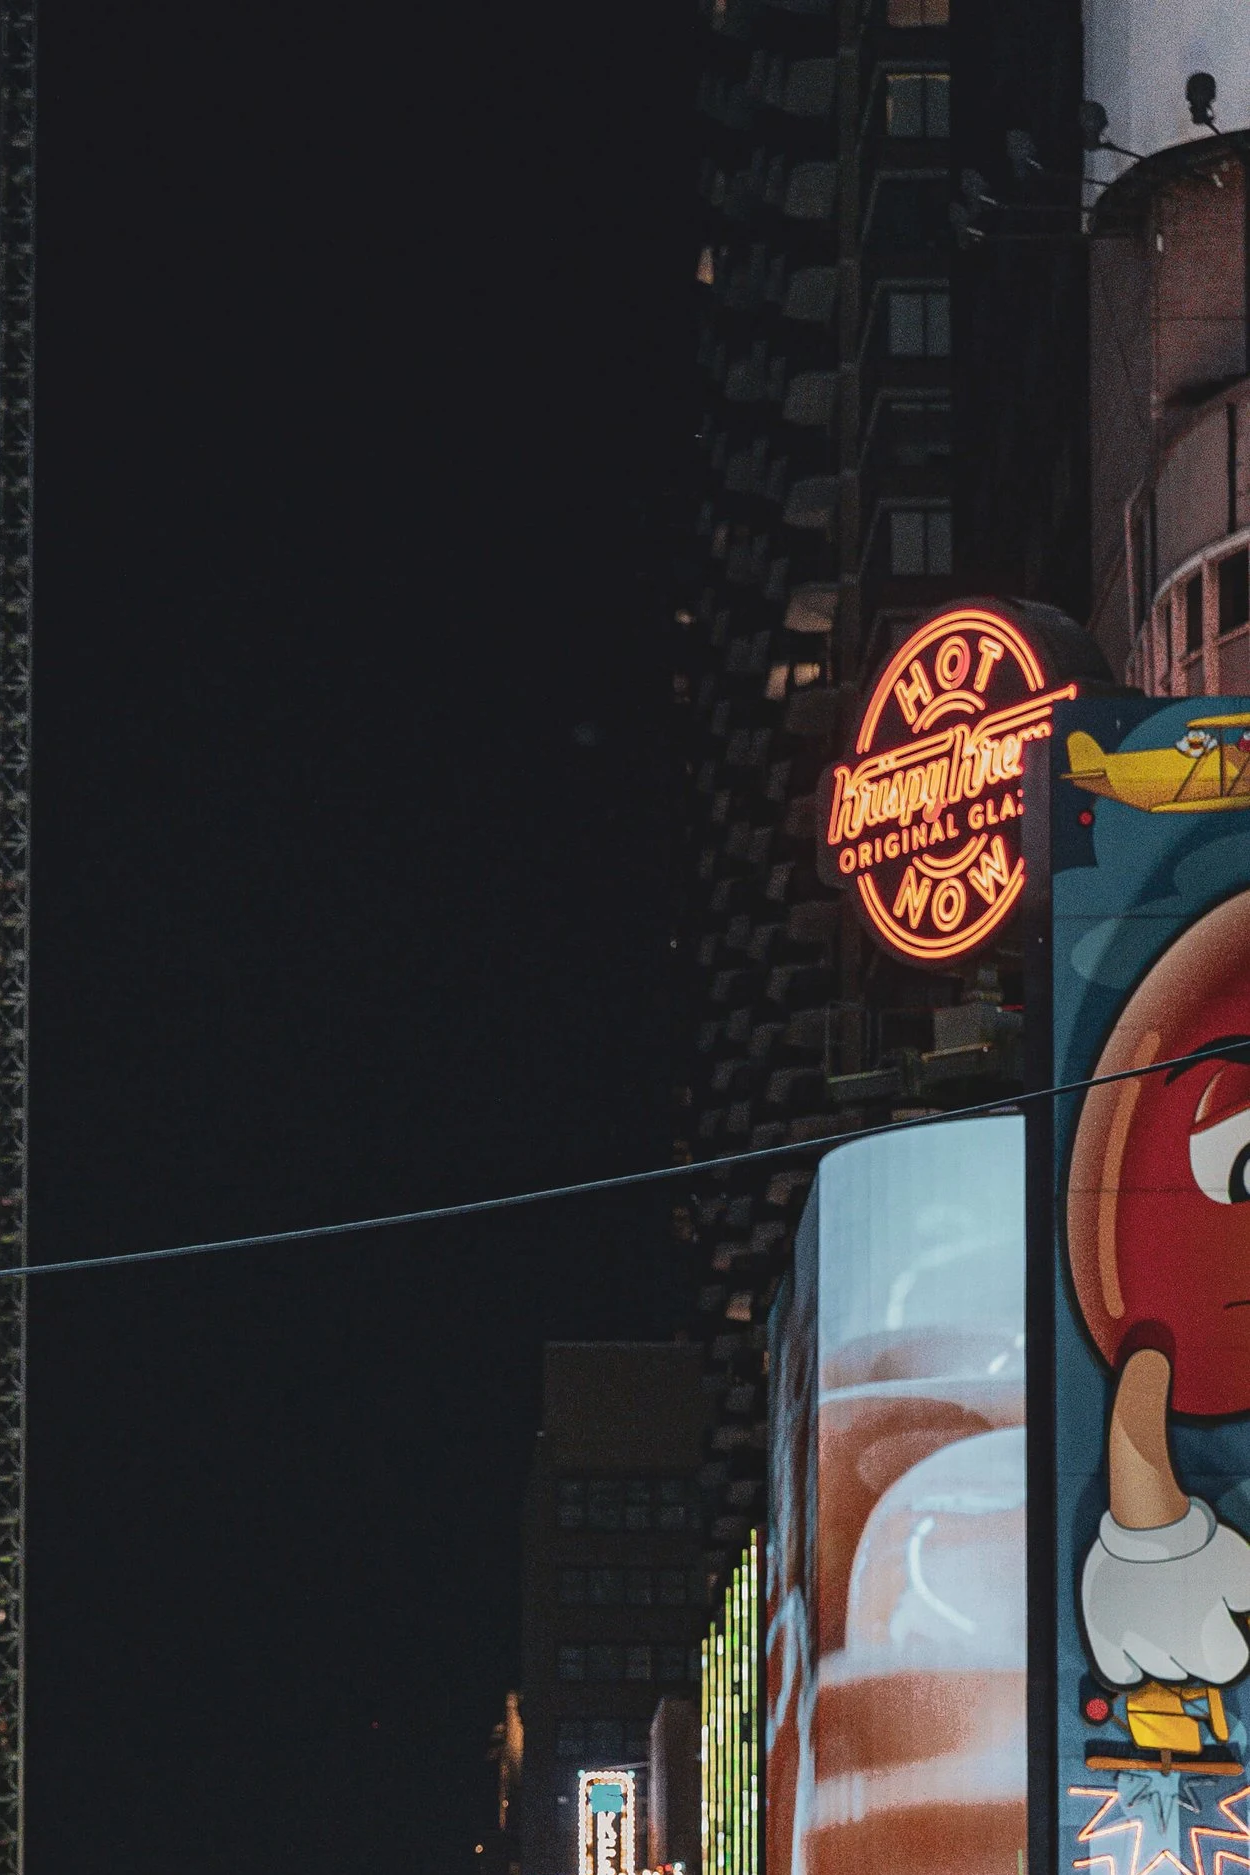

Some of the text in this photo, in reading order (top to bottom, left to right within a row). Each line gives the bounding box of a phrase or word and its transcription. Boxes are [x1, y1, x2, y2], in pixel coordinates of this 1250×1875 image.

[895, 635, 1005, 725] HOT
[827, 730, 954, 845] Krispy
[839, 811, 959, 874] ORIGINAL
[892, 834, 1010, 930] NOW
